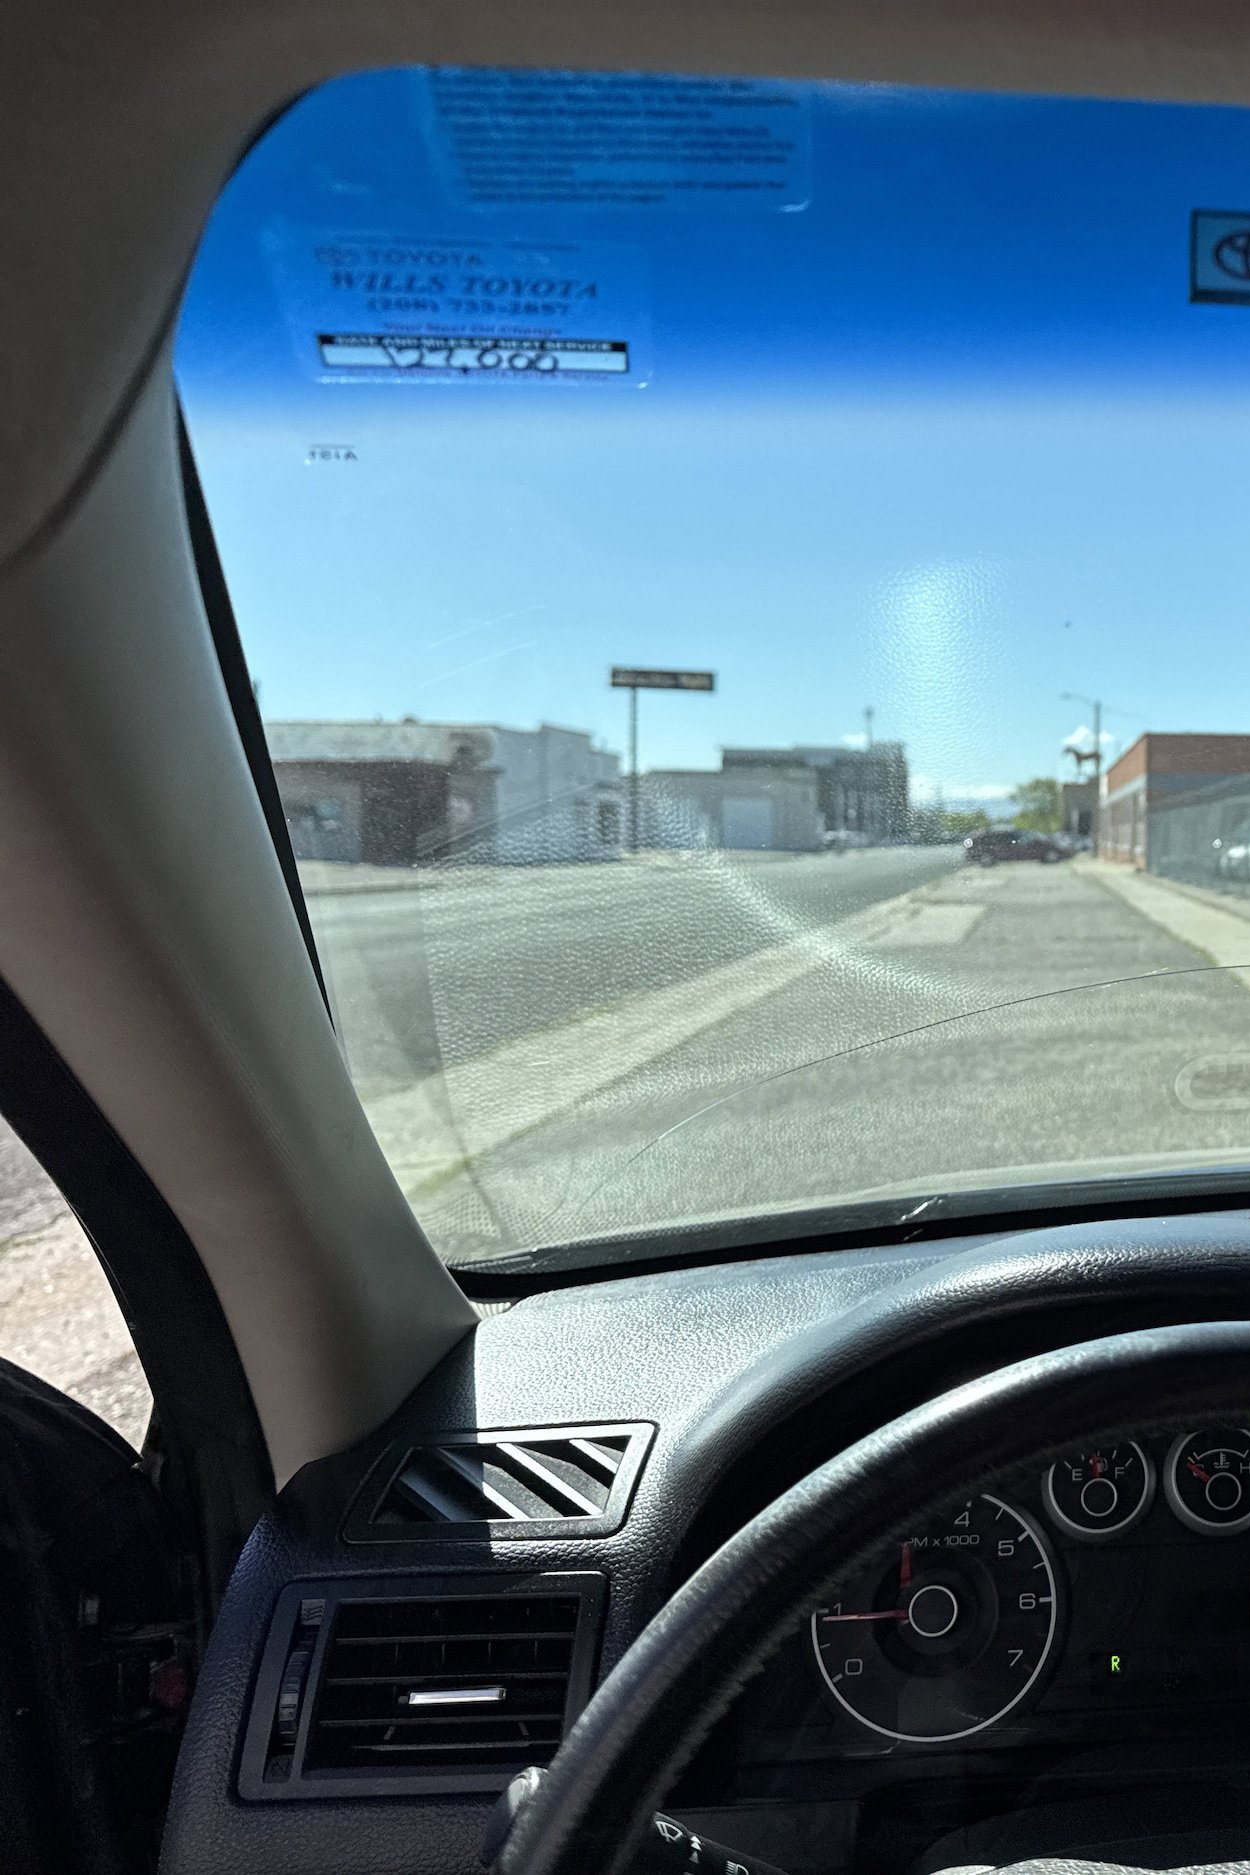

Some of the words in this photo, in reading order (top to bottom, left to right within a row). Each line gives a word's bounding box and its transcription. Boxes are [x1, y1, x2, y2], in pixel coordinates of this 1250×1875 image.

[366, 249, 483, 267] TOYOTA
[331, 271, 445, 294] WILLS
[463, 276, 597, 299] TOYOTA
[1072, 1468, 1083, 1481] E
[1114, 1466, 1125, 1479] F
[953, 1510, 970, 1528] 4
[904, 1537, 928, 1548] PM
[944, 1535, 980, 1546] 1000
[998, 1540, 1015, 1556] 5
[833, 1602, 842, 1616] 1
[1019, 1593, 1036, 1609] 6
[1008, 1649, 1024, 1667] 7
[1110, 1655, 1121, 1672] R
[844, 1658, 863, 1675] 0
